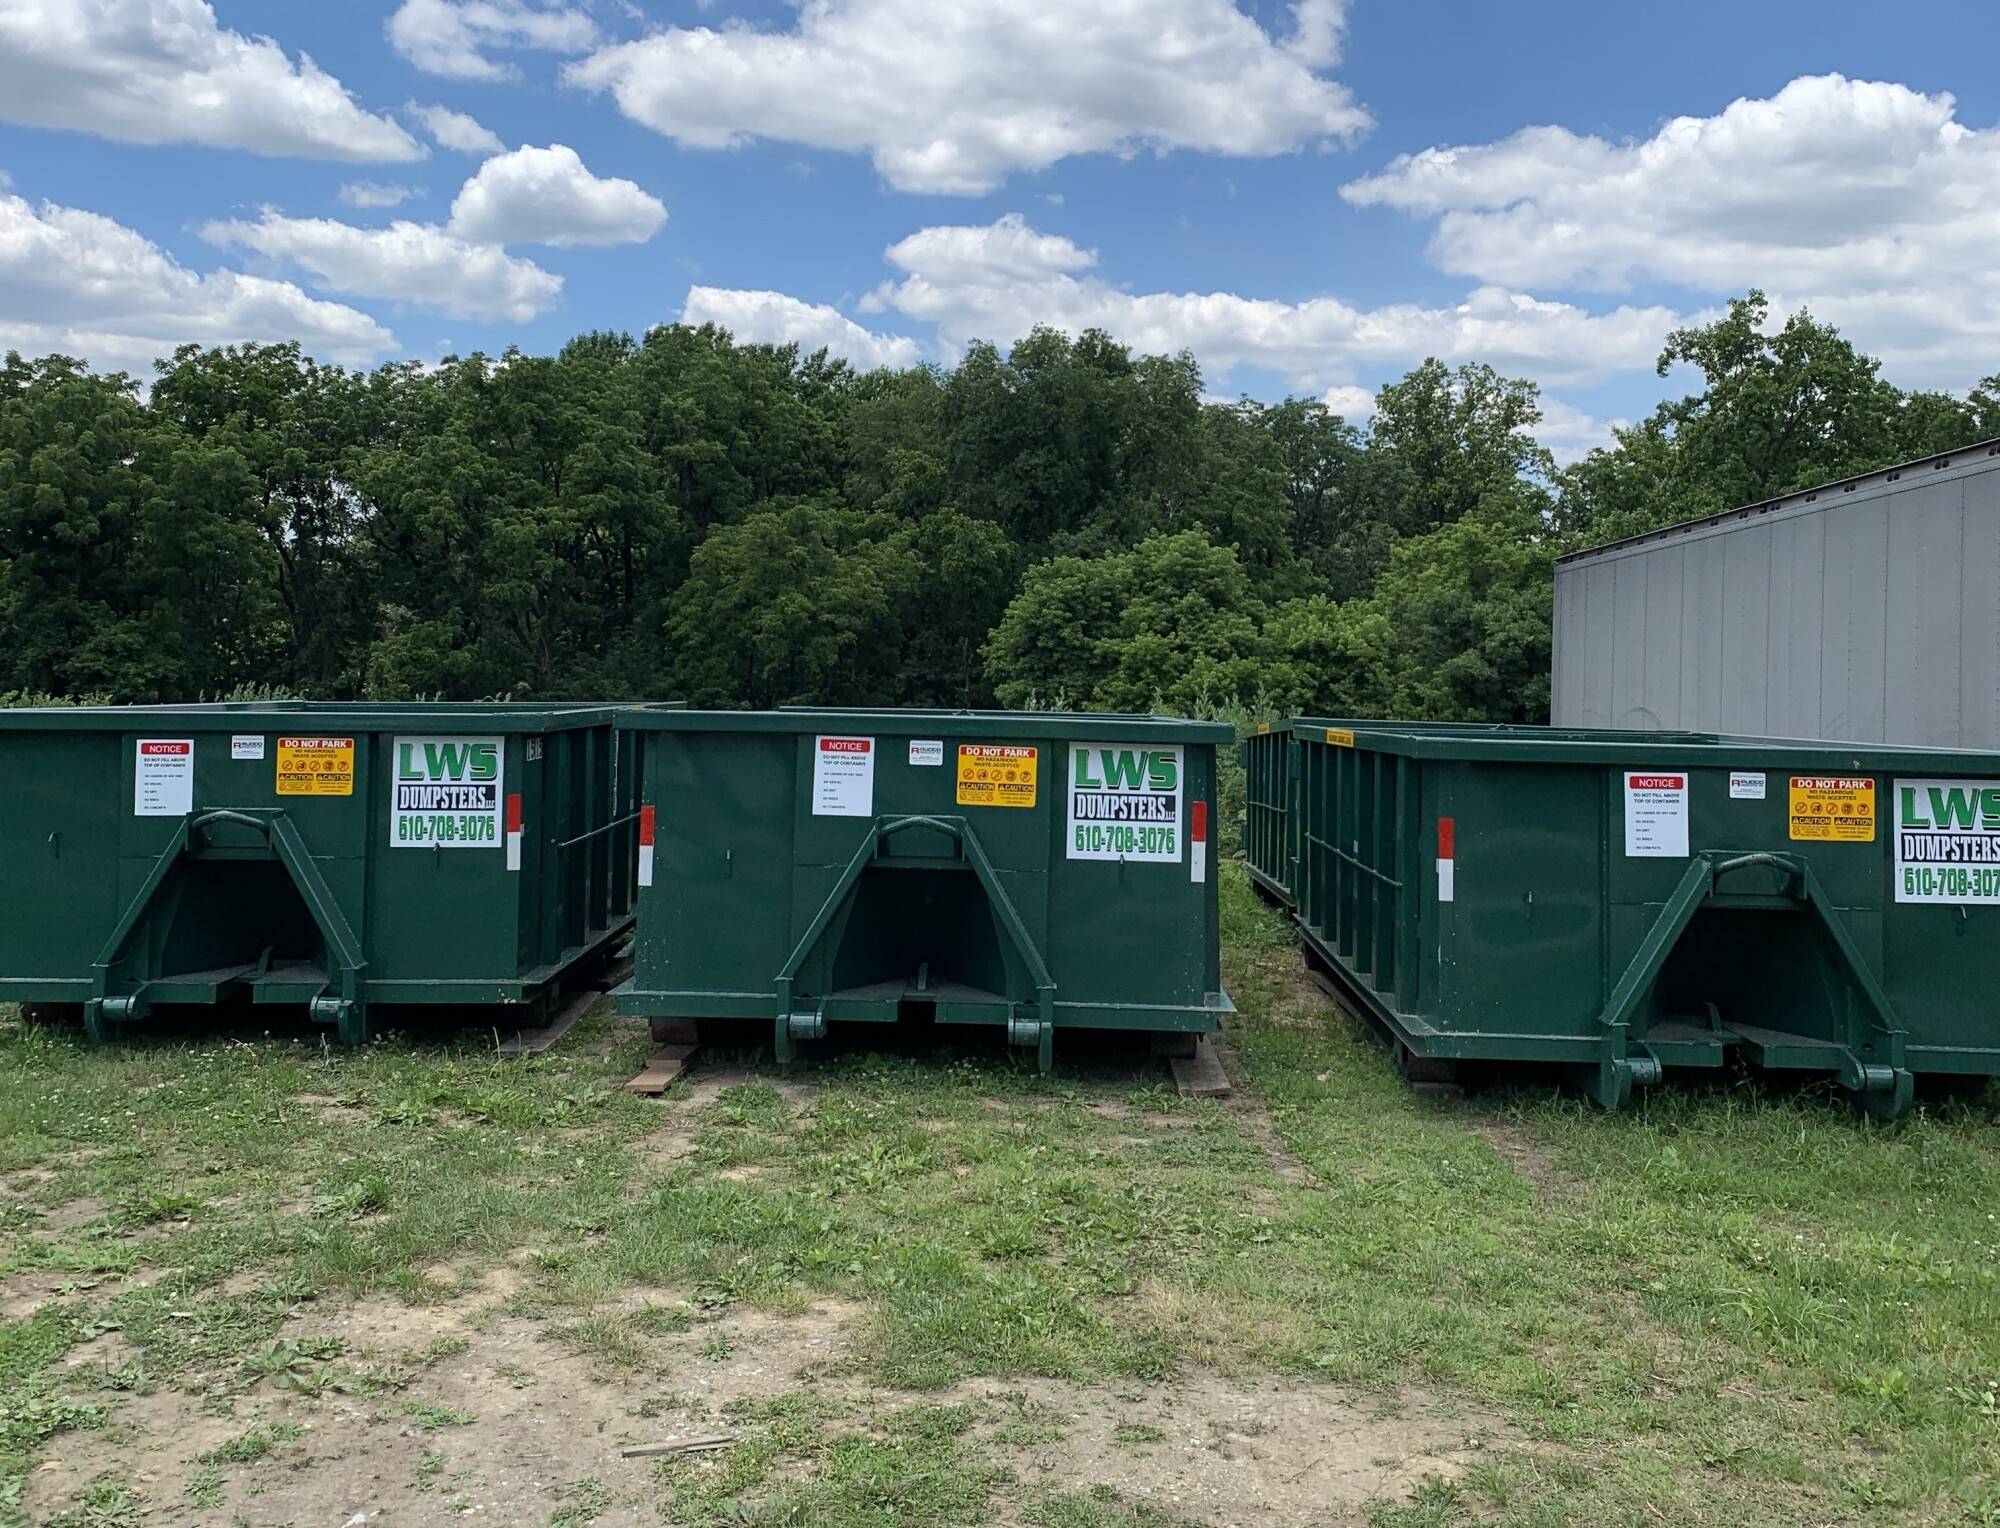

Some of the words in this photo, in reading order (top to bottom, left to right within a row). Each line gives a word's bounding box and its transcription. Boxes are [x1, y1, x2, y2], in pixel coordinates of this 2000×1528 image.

[149, 745, 182, 753] NOTICE
[285, 740, 300, 748] DO
[301, 740, 320, 748] NOT
[321, 740, 347, 748] PARK
[829, 742, 863, 751] NOTICE
[966, 747, 980, 755] DO
[982, 747, 1002, 756] NOT
[1004, 749, 1030, 757] PARK
[399, 743, 497, 781] LWS
[1075, 749, 1177, 791] LWS
[1638, 778, 1675, 788] NOTICE
[1797, 780, 1813, 788] DO
[1815, 780, 1837, 788] NOT
[1839, 780, 1867, 789] PARK
[400, 786, 486, 809] DUMPSTERS
[1076, 794, 1166, 820] DUMPSTERS
[1901, 787, 2000, 830] LWS
[399, 815, 494, 841] 610-708-3076
[1075, 825, 1175, 853] 610-708-3076
[1903, 835, 2000, 862] DUMPSTERS
